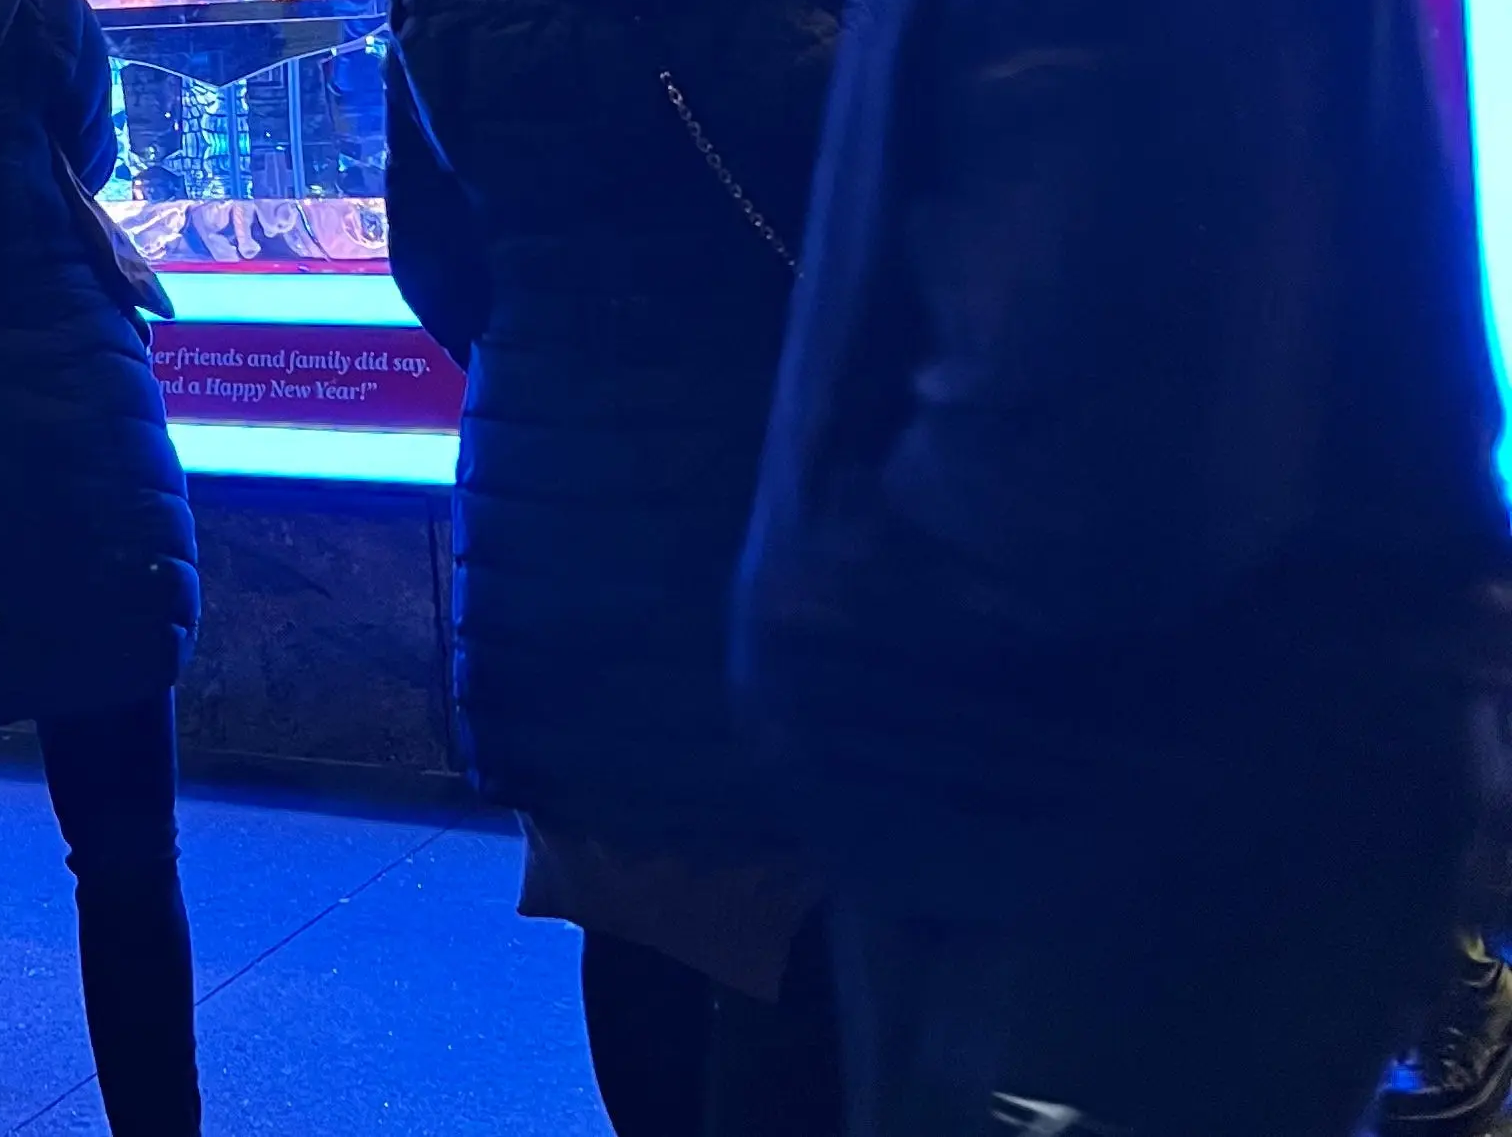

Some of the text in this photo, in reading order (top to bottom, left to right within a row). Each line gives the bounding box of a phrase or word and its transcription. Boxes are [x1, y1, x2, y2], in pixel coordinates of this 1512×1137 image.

[154, 346, 431, 379] er friends and family did say.
[159, 375, 185, 395] nd
[188, 380, 202, 395] a
[205, 377, 267, 403] Happy
[270, 378, 312, 399] New
